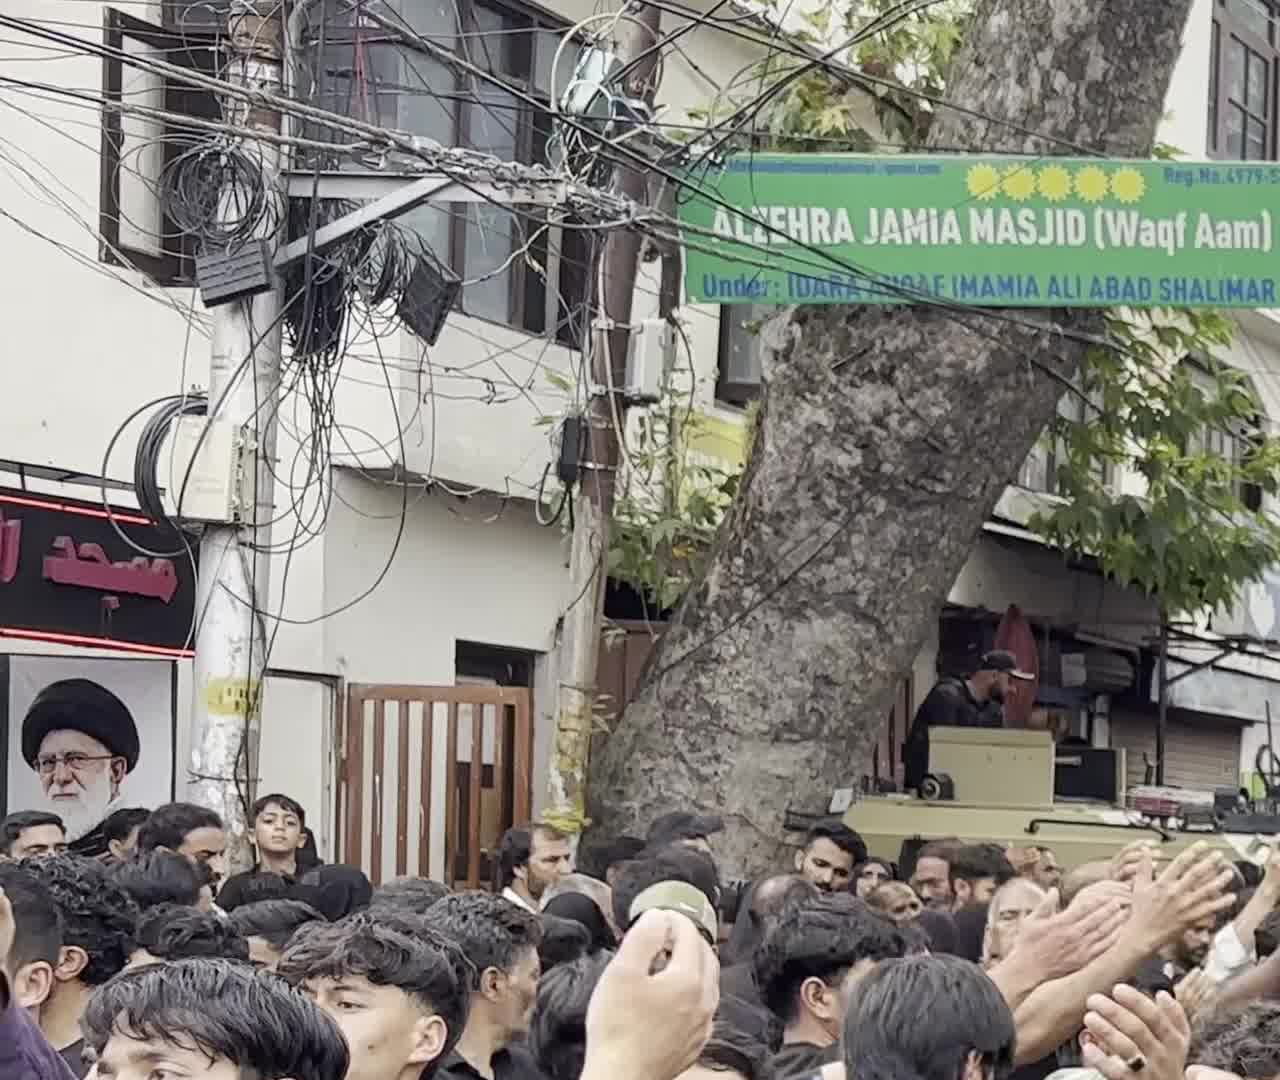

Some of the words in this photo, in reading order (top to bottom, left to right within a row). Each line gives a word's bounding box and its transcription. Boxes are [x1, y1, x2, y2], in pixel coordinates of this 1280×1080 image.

[863, 207, 962, 245] JAMIA
[969, 208, 1085, 246] MASJID
[1094, 207, 1188, 257] (Waqf
[1195, 210, 1273, 252] Aam)
[787, 273, 858, 300] IDARA
[952, 274, 1040, 300] IMAMIA
[1047, 276, 1081, 300] ALI
[1090, 277, 1152, 301] ABAD
[1160, 278, 1275, 302] SHALIMAR
[42, 535, 177, 609] مسجد
